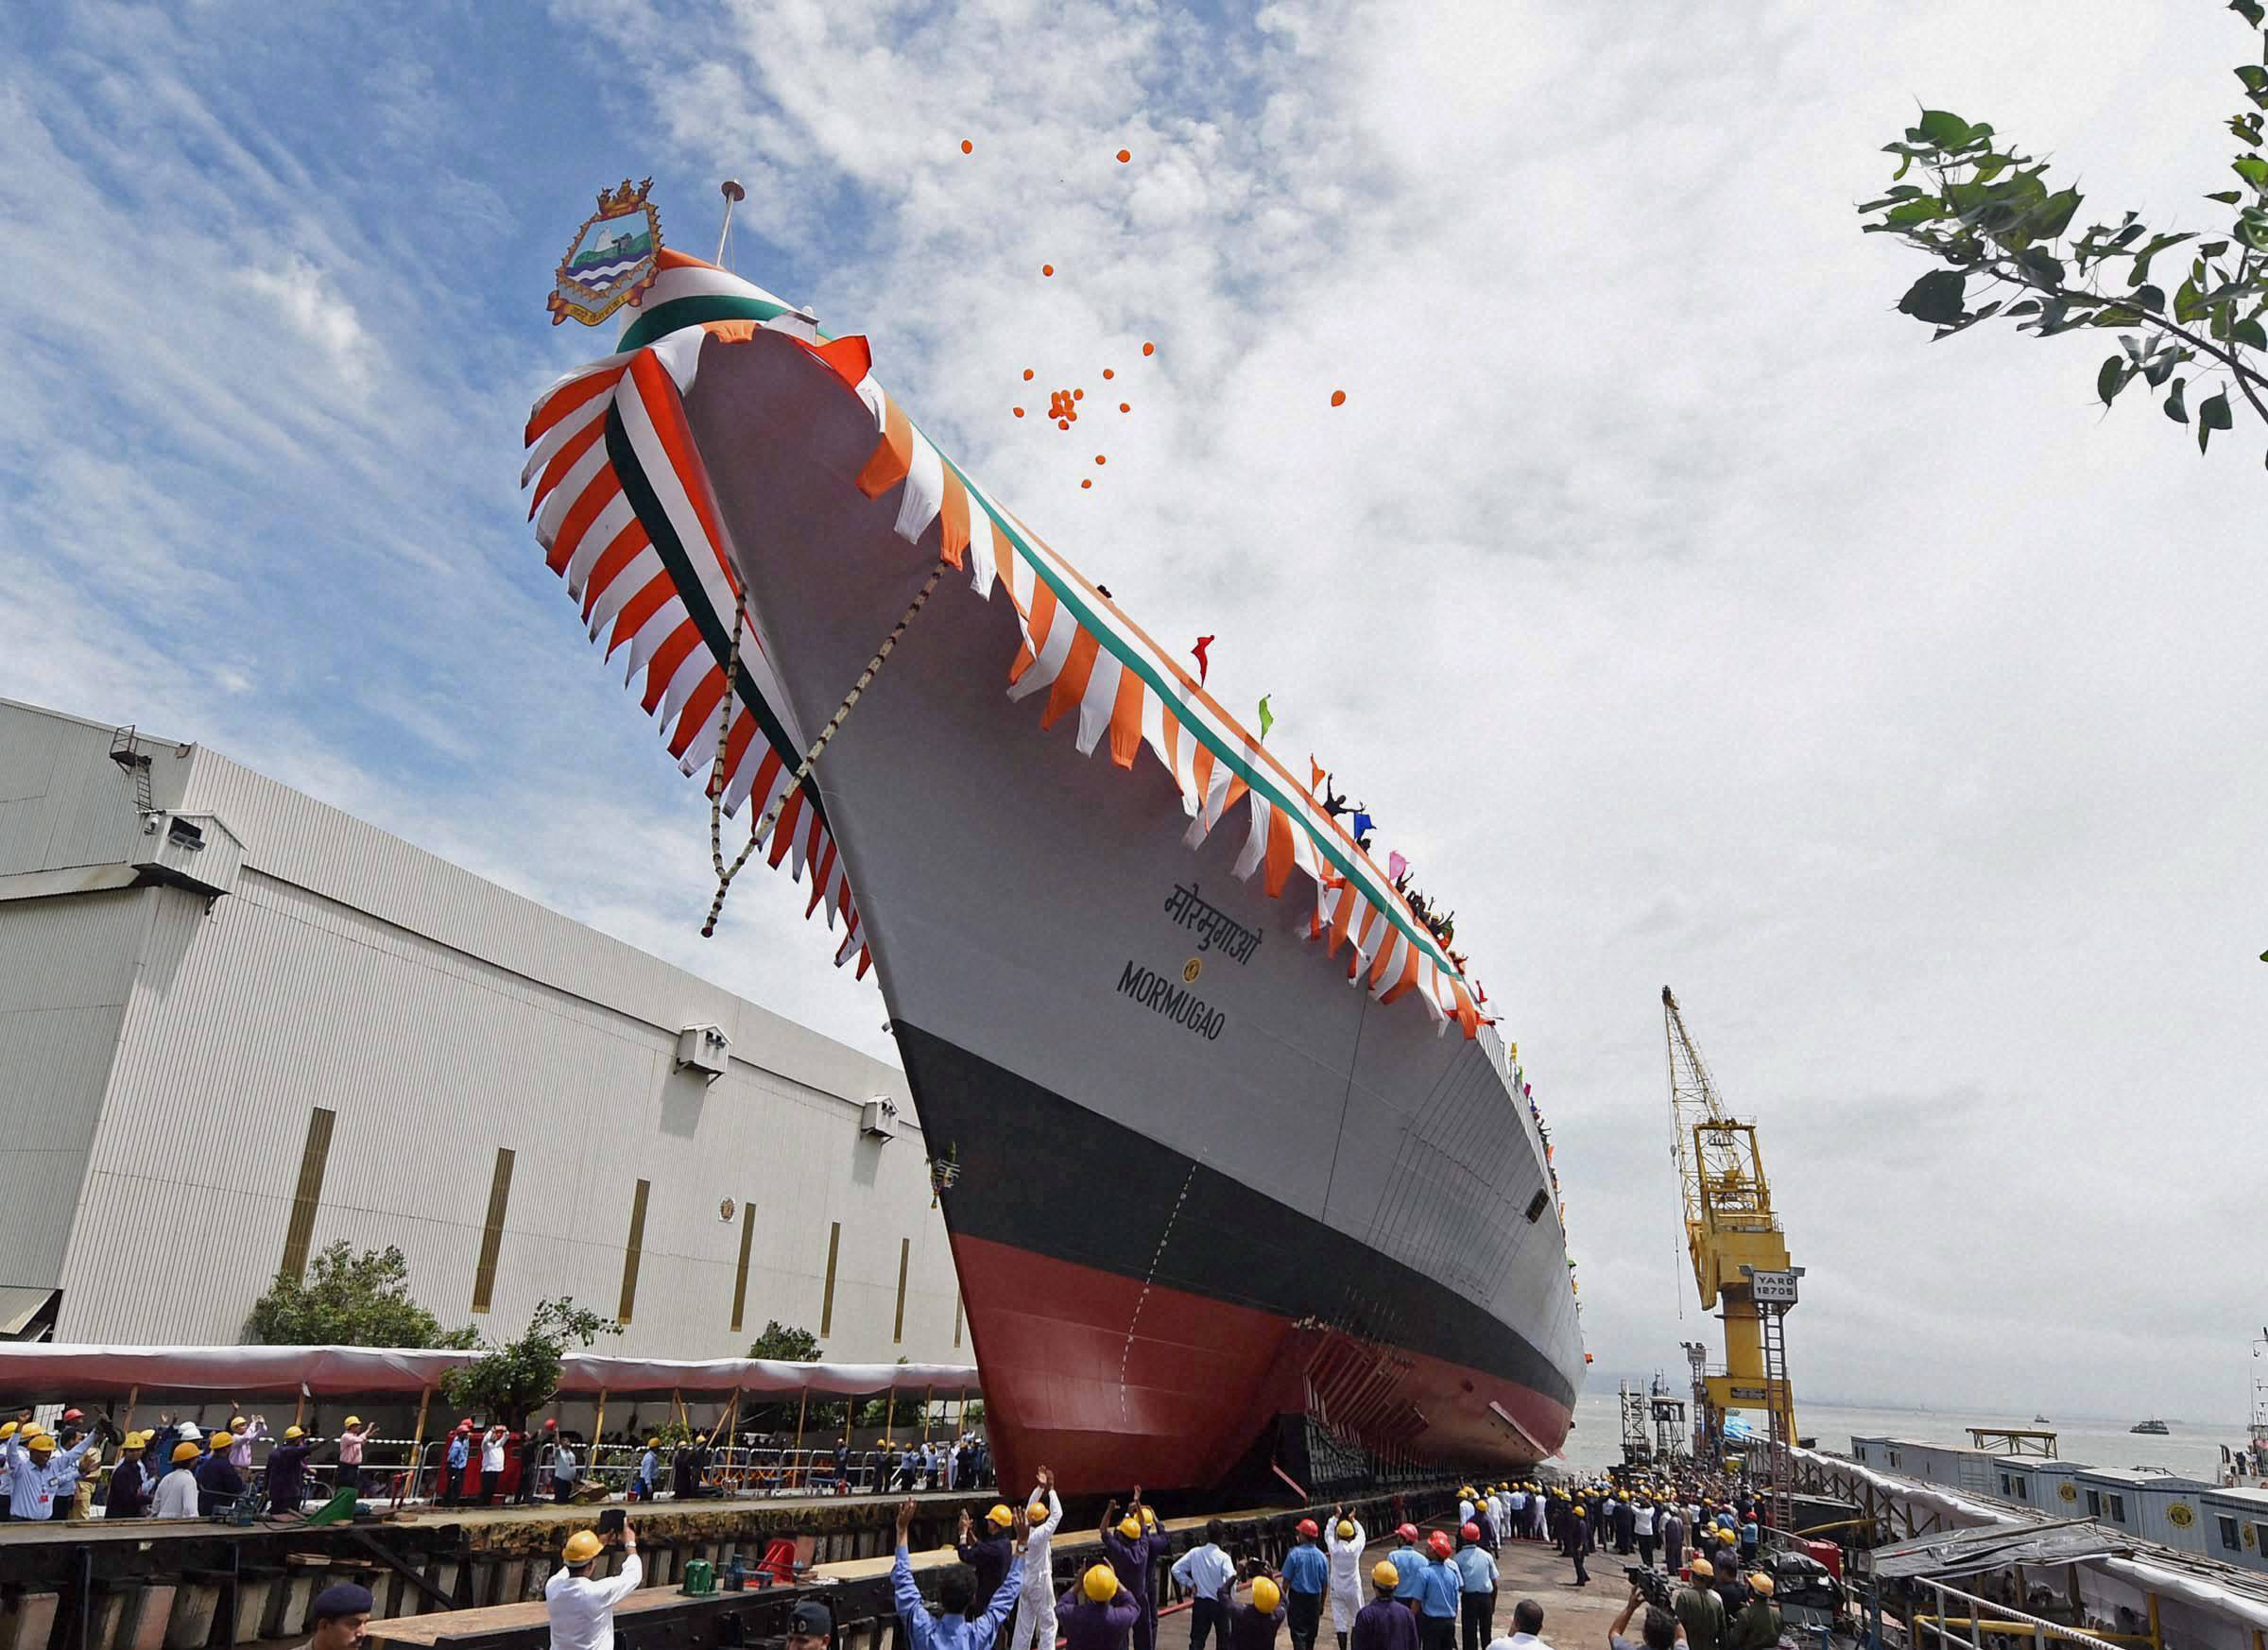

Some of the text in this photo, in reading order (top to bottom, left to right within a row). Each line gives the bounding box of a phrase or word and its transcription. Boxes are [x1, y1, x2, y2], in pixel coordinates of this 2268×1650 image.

[1164, 882, 1263, 966] मोरमुगाओ
[1116, 959, 1226, 1040] MORMUGAO
[1757, 1286, 1794, 1296] 12705
[1758, 1276, 1794, 1285] YARD
